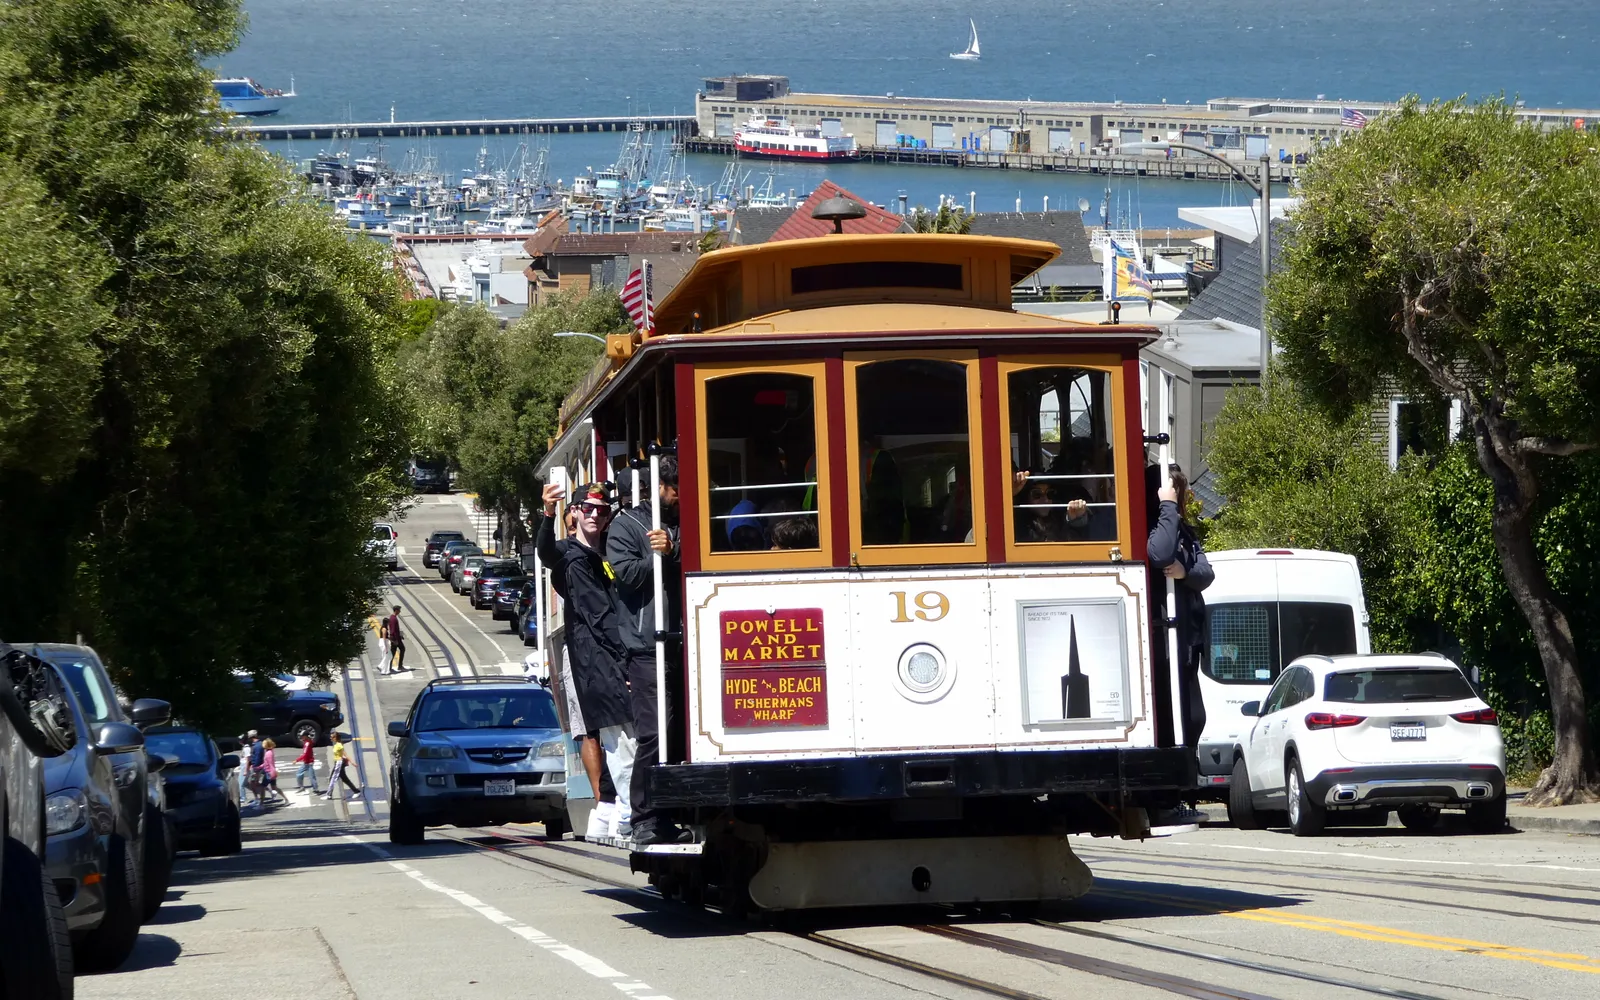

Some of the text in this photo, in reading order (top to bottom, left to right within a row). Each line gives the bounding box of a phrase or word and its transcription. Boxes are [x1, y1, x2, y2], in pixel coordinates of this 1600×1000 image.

[888, 590, 950, 623] 19
[726, 619, 819, 634] POWELL
[751, 634, 797, 645] AND
[724, 645, 821, 661] MARKET
[726, 677, 822, 694] HYDE AND BEACH
[734, 697, 814, 709] FISHERMANS
[753, 709, 795, 720] WHARF
